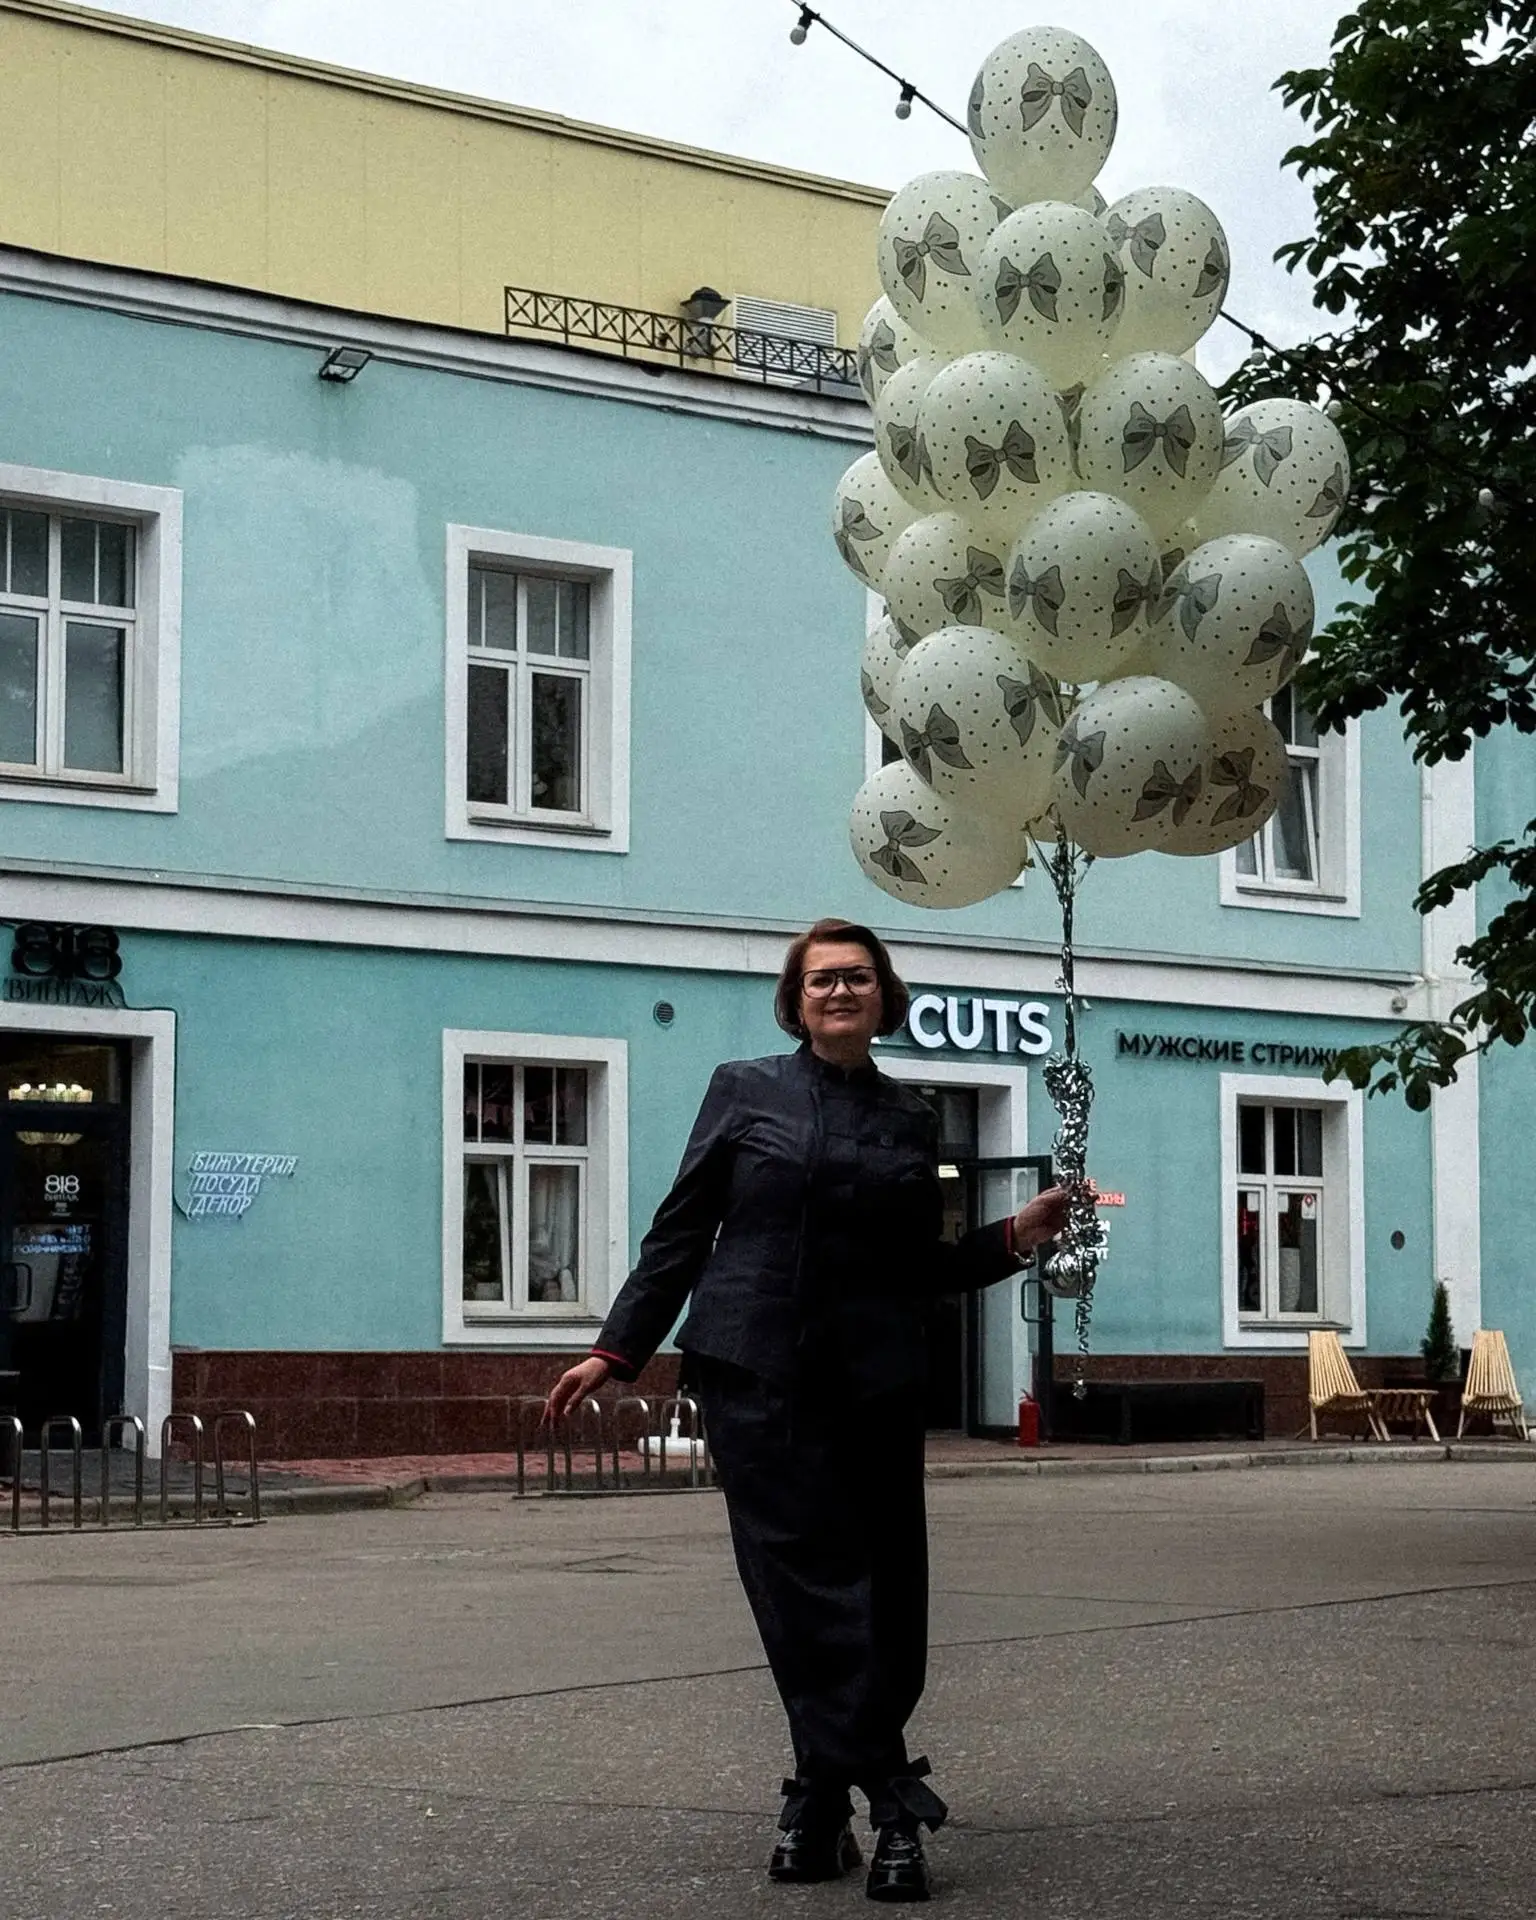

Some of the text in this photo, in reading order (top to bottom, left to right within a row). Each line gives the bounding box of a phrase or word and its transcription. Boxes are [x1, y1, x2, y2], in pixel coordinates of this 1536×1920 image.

[11, 920, 123, 981] 818
[9, 978, 117, 1006] ВИНТАЖ
[909, 994, 1052, 1055] CUTS
[1117, 1031, 1245, 1063] МУЖСКИЕ
[193, 1152, 298, 1174] БИЖУТЕРИЯ
[44, 1175, 80, 1193] 818
[192, 1173, 262, 1196] ПОСУДА
[191, 1195, 253, 1216] ДЕКОР
